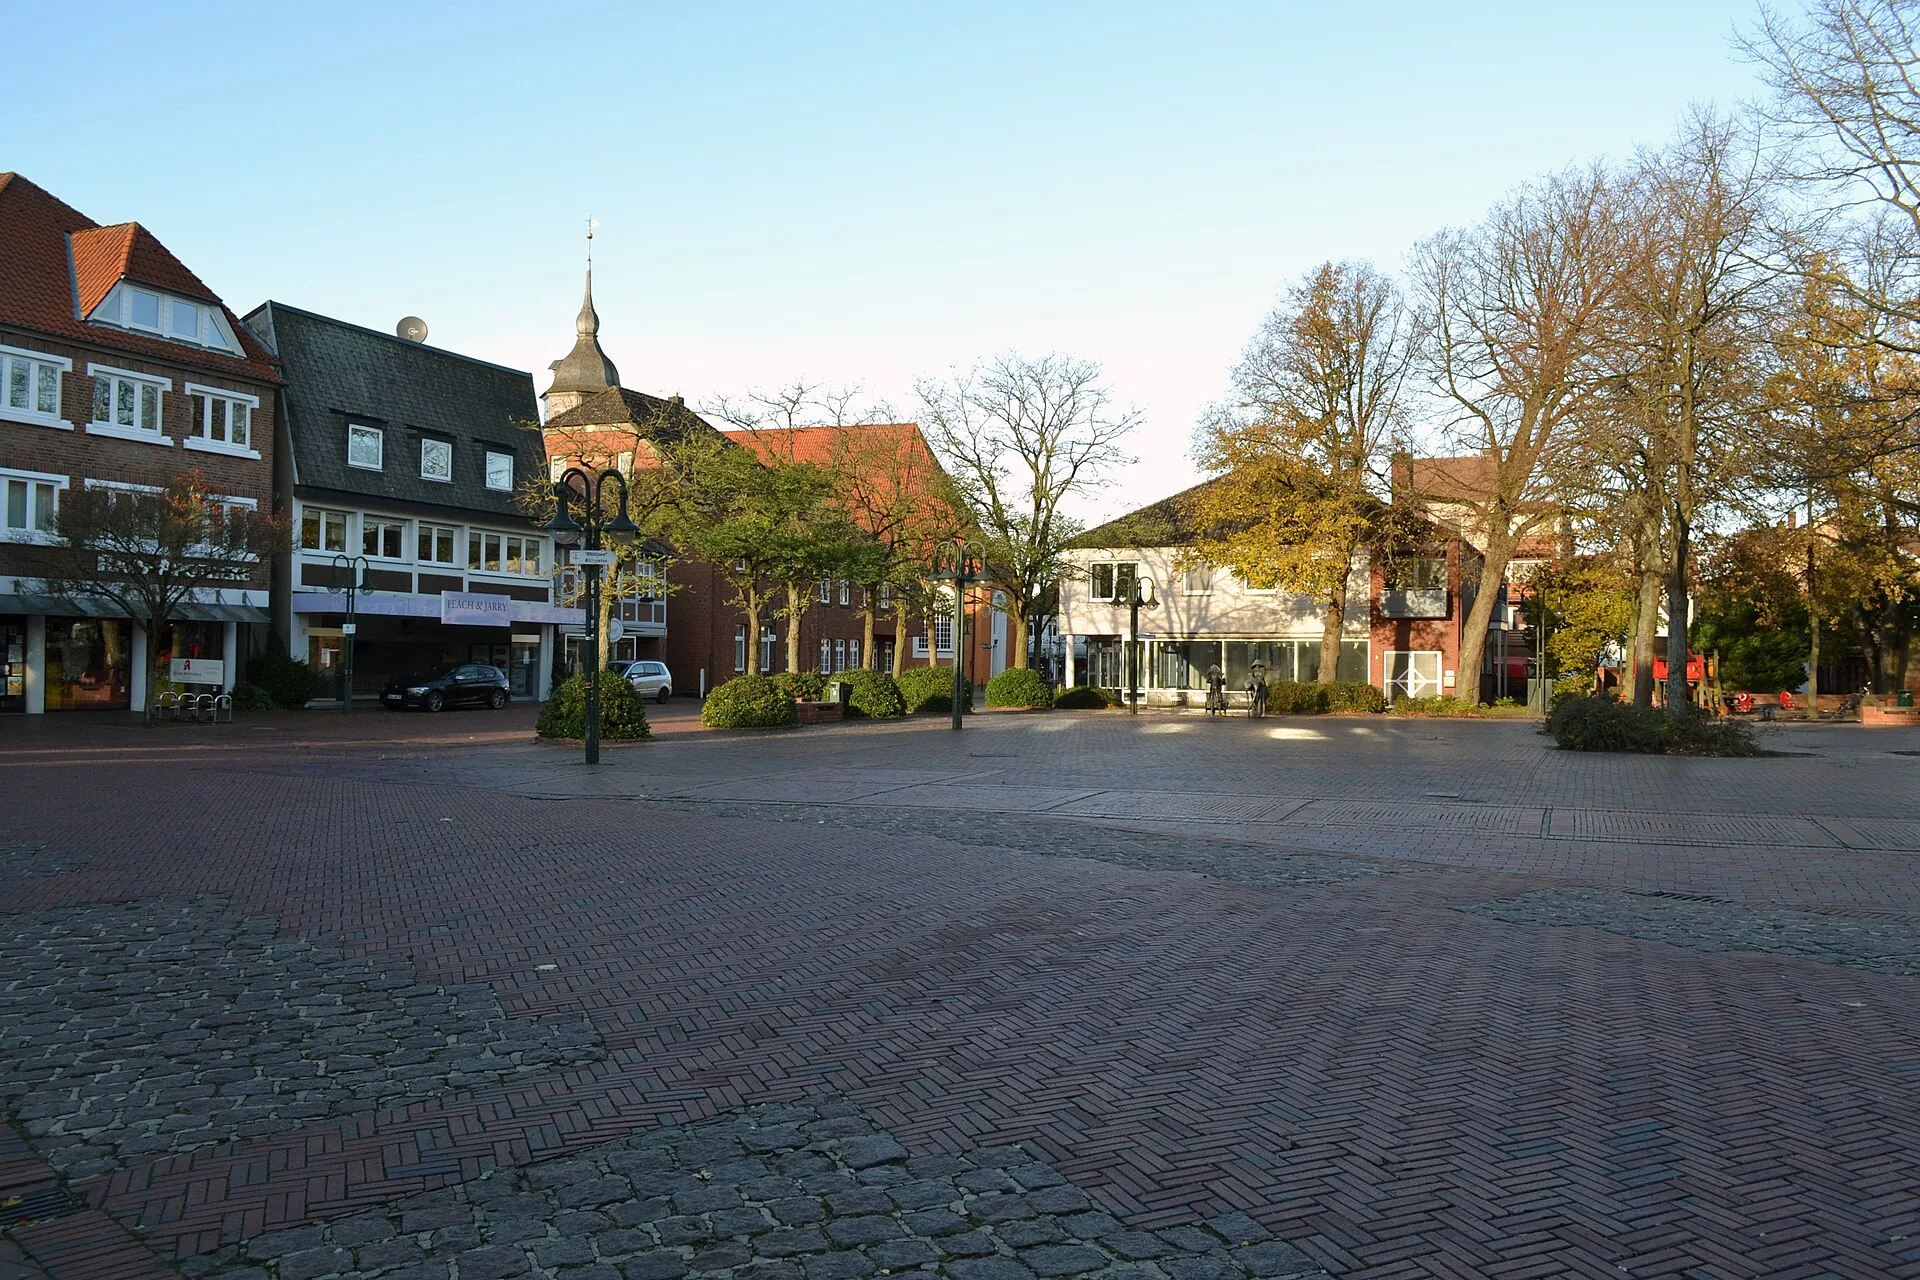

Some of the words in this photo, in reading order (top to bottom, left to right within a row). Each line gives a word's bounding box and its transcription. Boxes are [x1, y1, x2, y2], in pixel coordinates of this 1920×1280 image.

[447, 599, 474, 610] PEACH
[475, 601, 483, 611] &
[484, 602, 508, 612] JARRY
